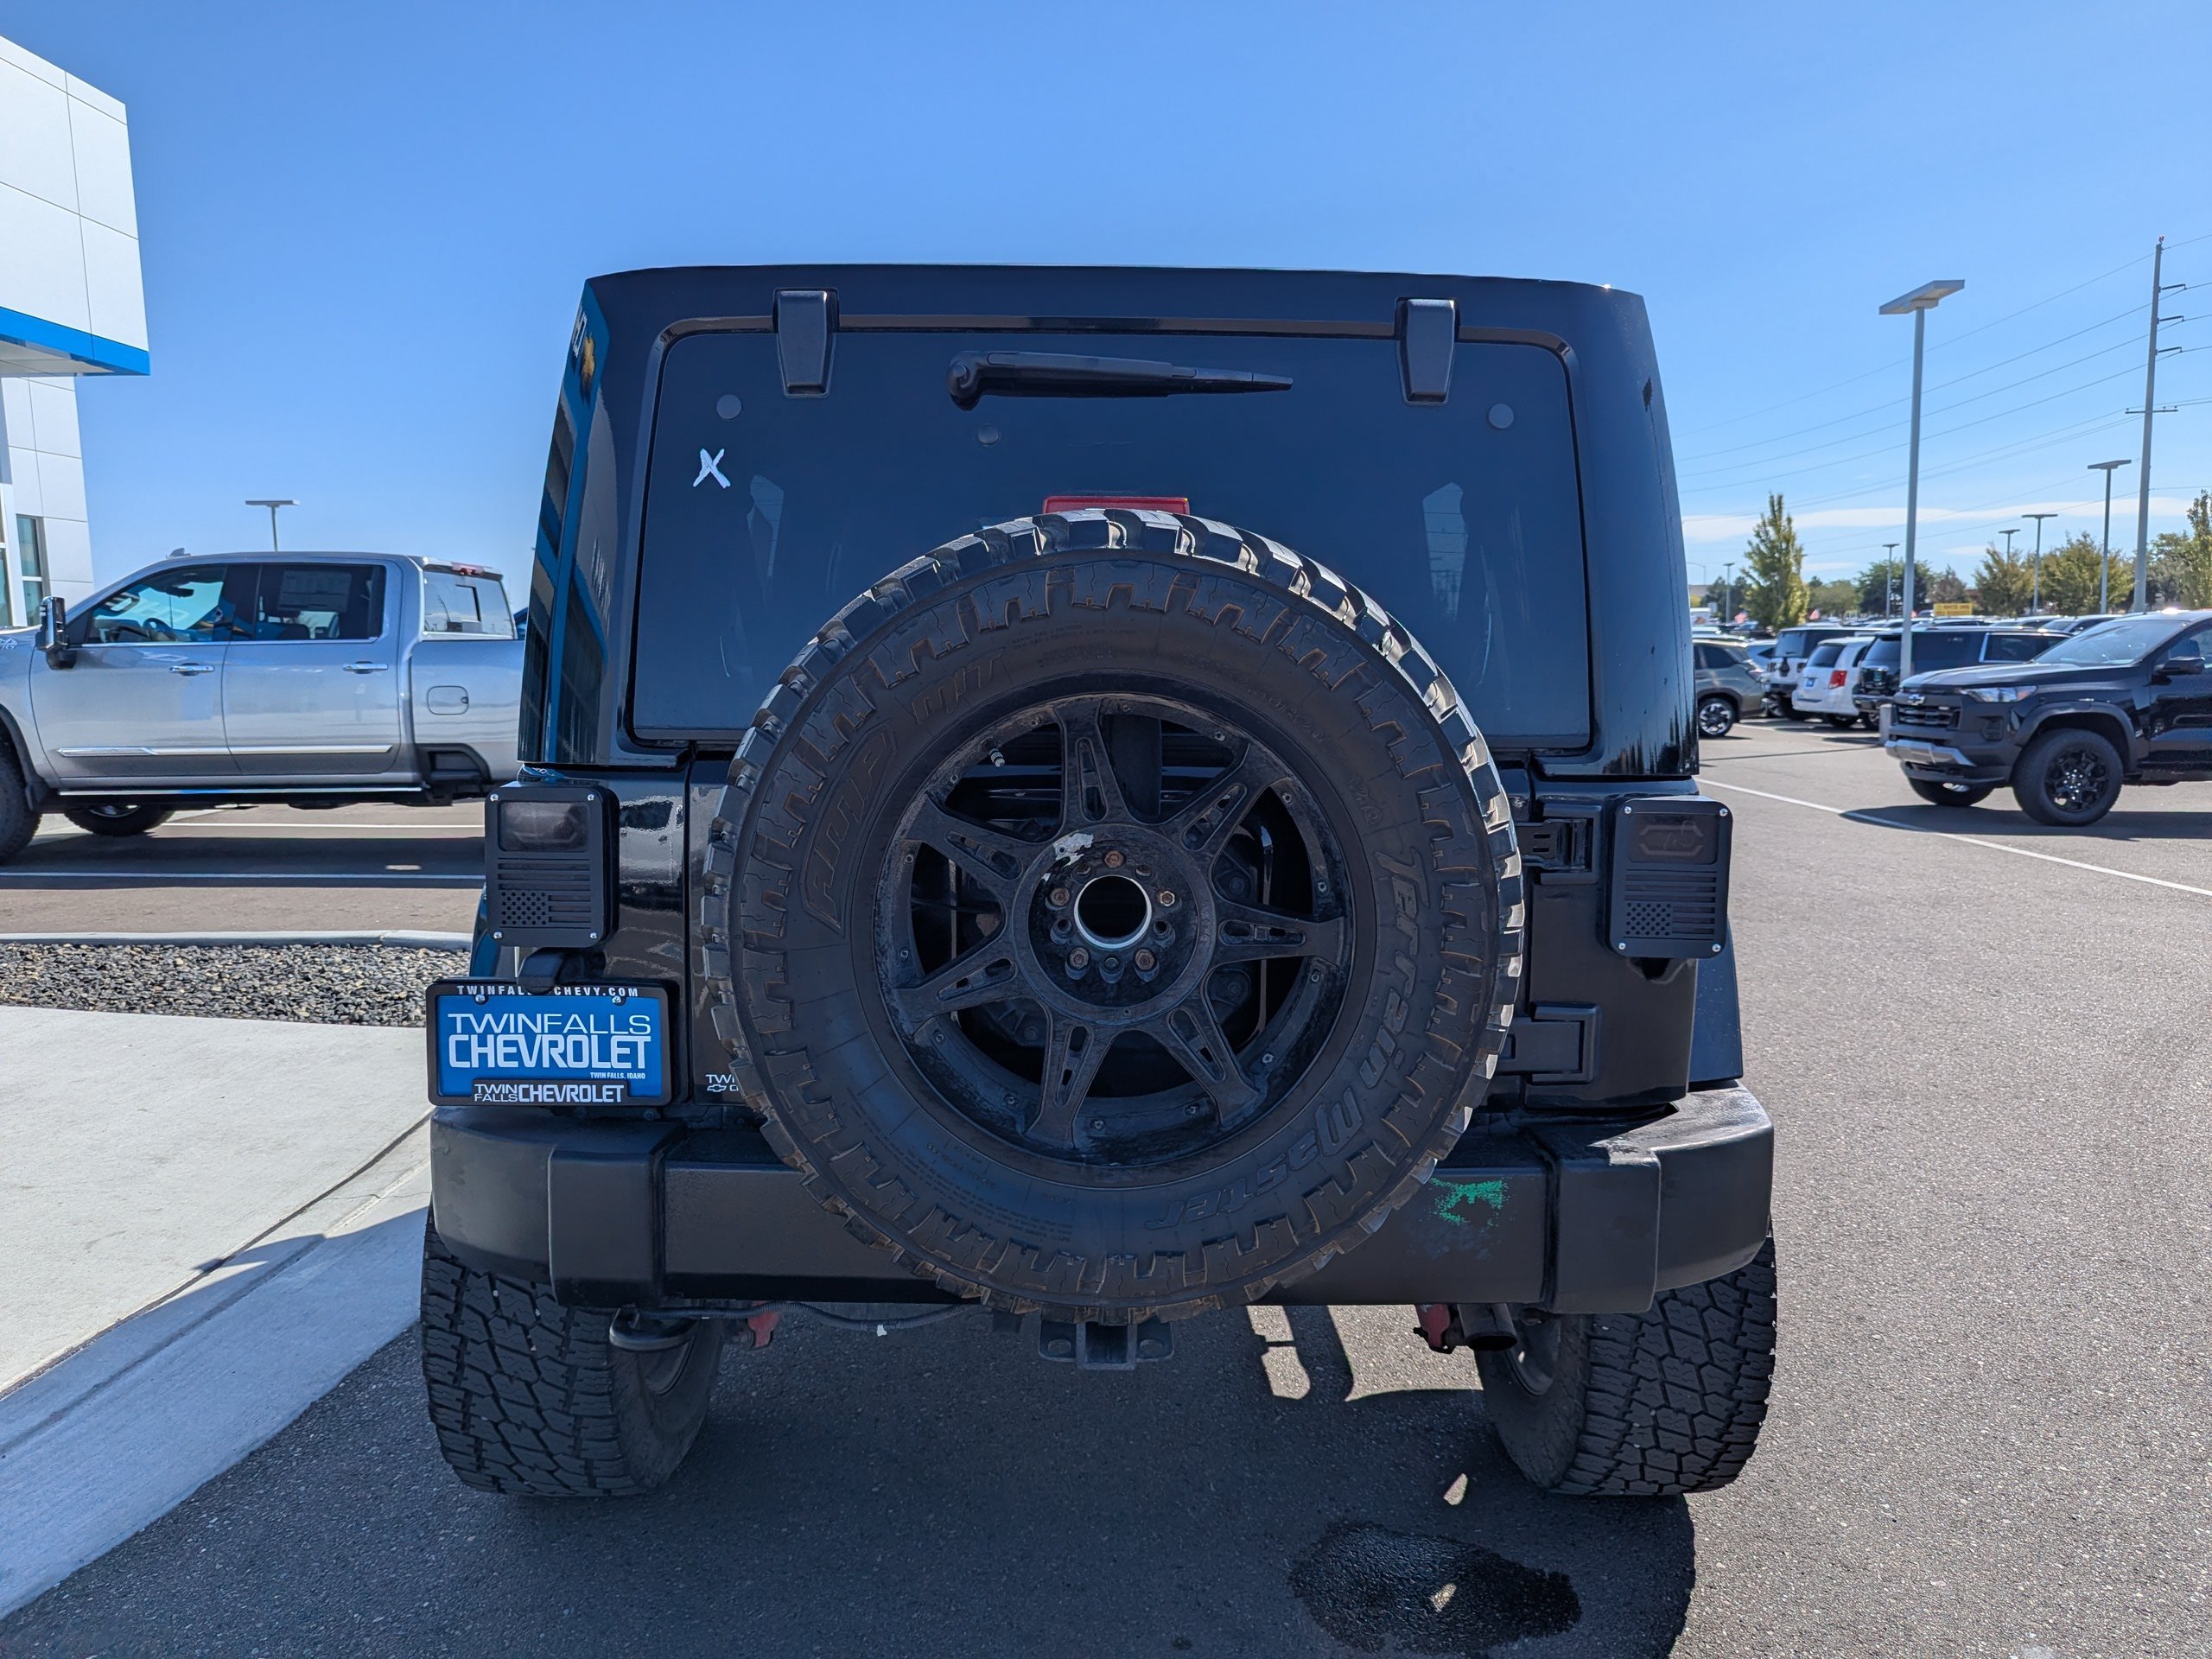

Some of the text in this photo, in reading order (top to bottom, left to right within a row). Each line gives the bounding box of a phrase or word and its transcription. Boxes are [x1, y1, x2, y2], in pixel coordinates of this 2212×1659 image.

[692, 448, 731, 489] X
[448, 1013, 652, 1035] TWINFALLS
[1144, 845, 1431, 1230] Terrain Master
[448, 1033, 652, 1069] CHEVROLET
[474, 1084, 518, 1094] TWIN
[474, 1093, 518, 1103] FALLS
[518, 1084, 625, 1103] CHEVROLET
